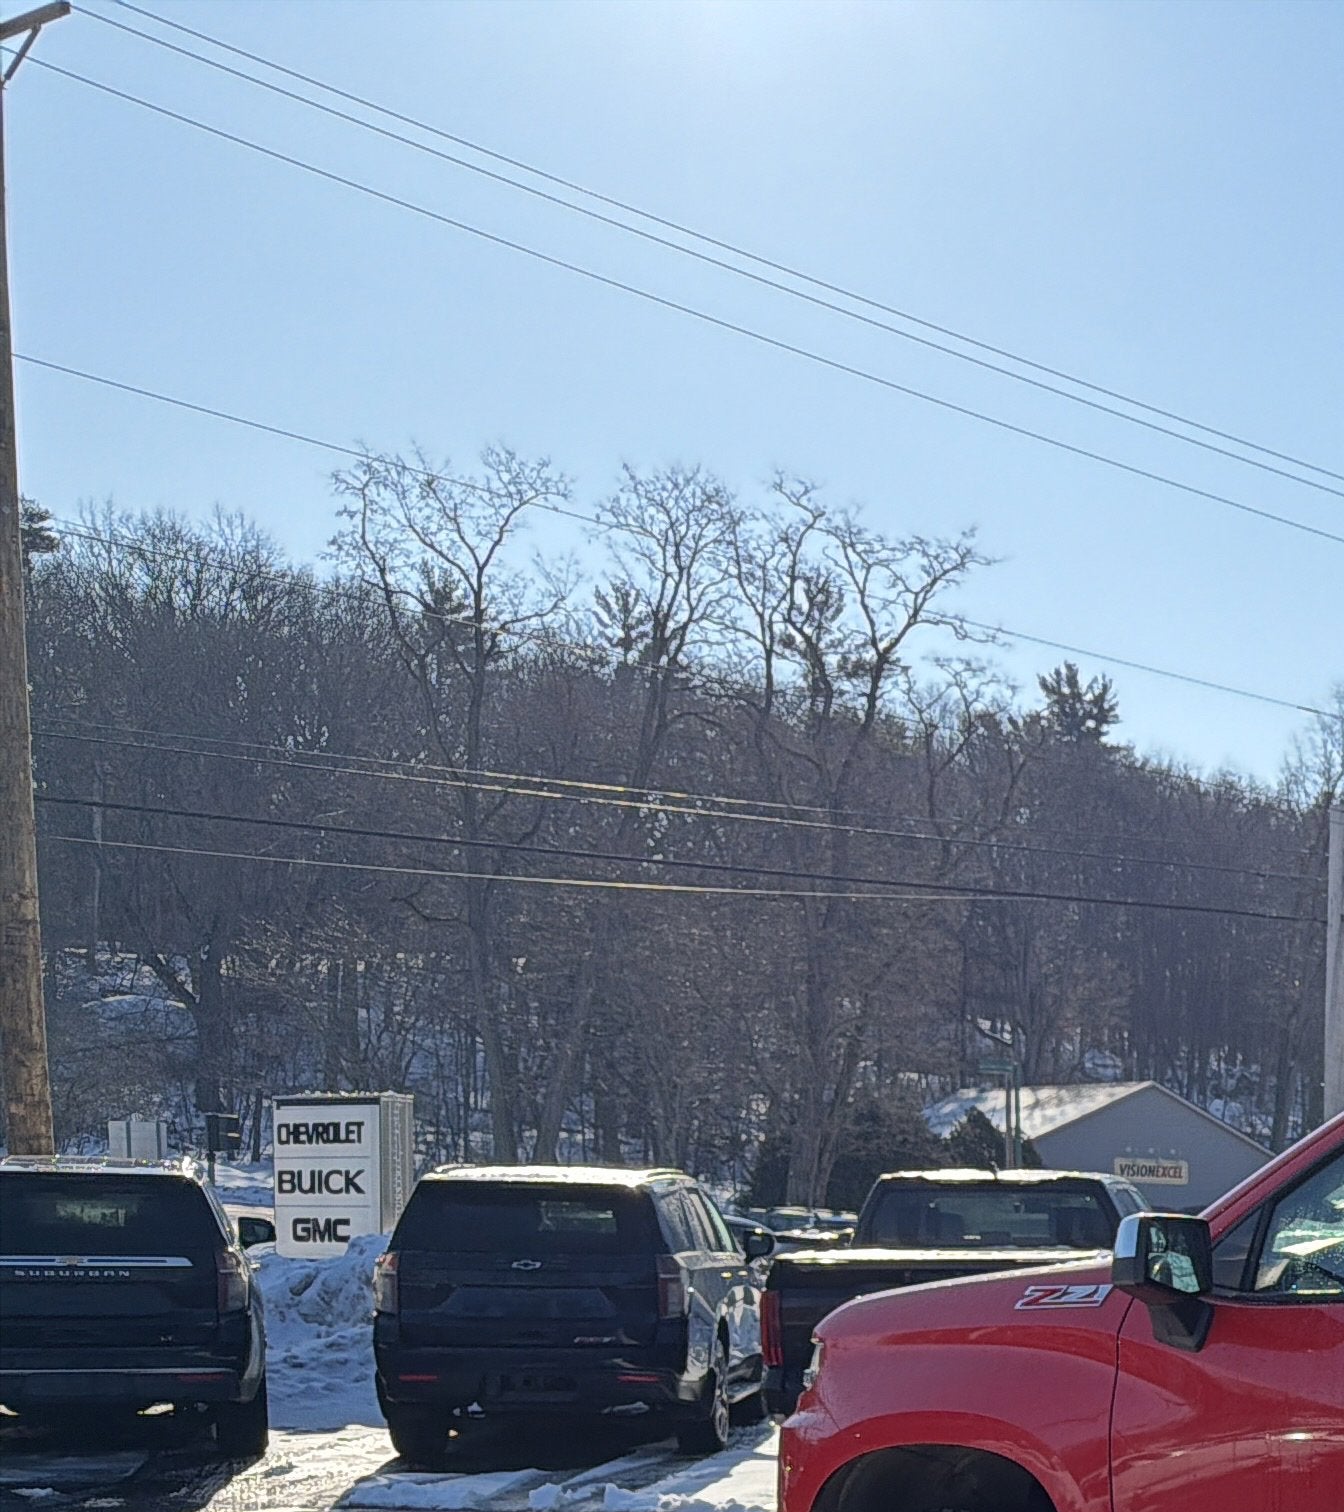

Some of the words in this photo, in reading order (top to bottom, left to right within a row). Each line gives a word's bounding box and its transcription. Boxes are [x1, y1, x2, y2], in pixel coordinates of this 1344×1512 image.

[277, 1121, 364, 1145] CHEVROLET
[277, 1169, 366, 1195] BUICK
[292, 1217, 350, 1242] GMC
[14, 1269, 130, 1277] SUBURBAN
